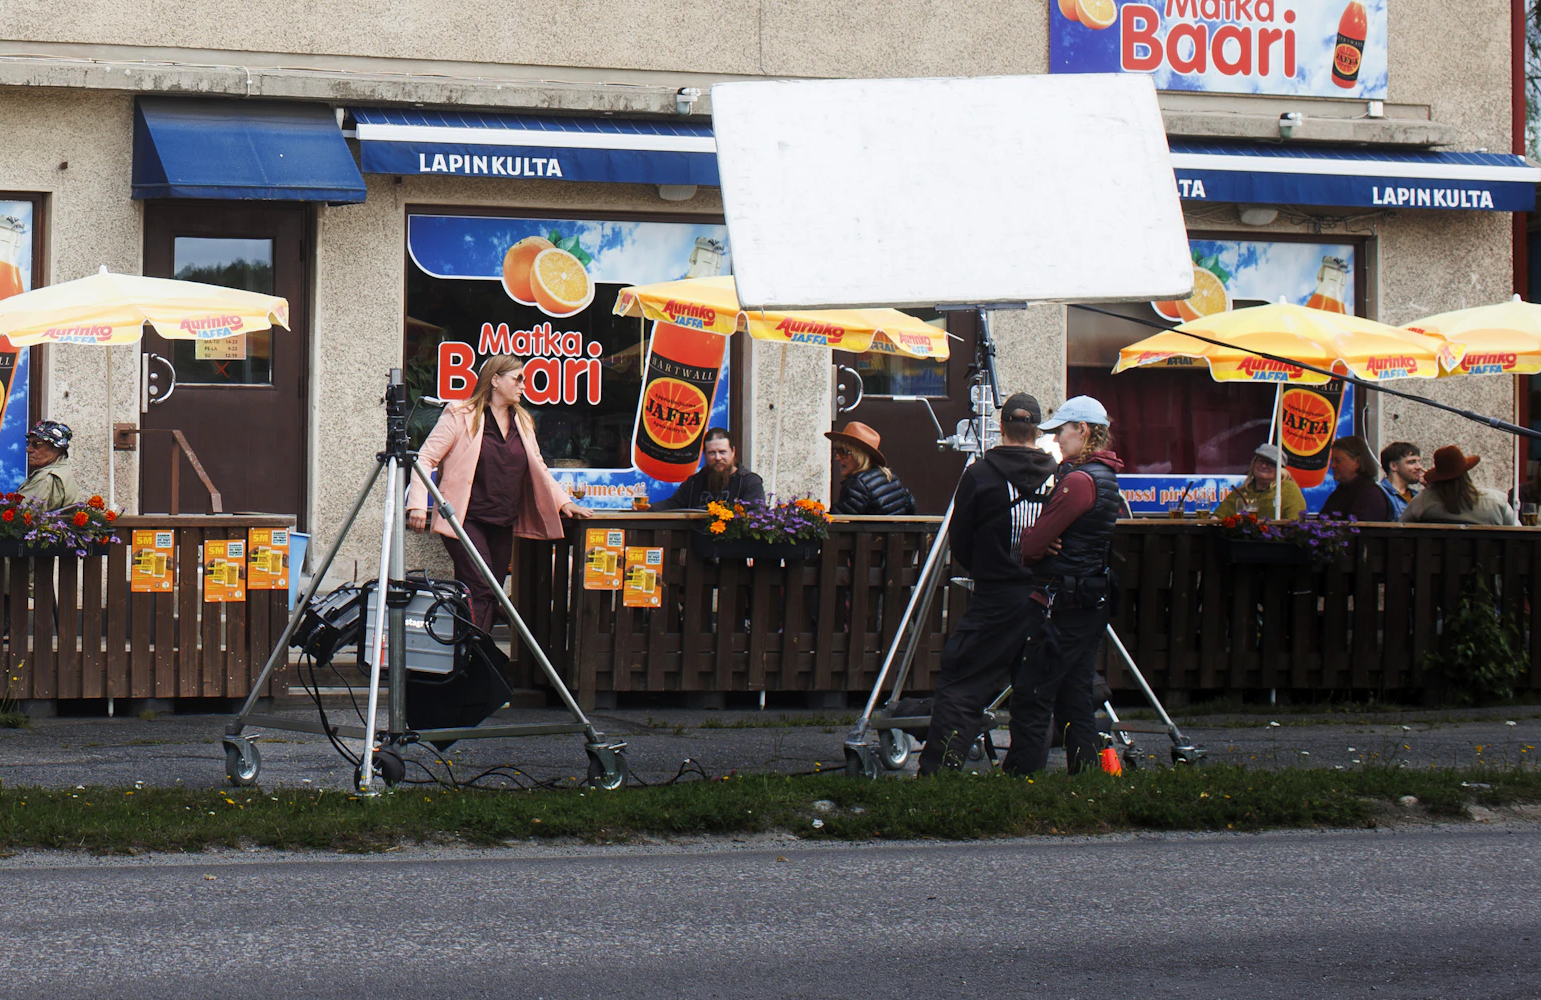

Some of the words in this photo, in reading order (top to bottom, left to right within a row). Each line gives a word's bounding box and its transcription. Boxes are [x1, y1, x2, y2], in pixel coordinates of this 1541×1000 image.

[1122, 3, 1296, 78] Baari
[662, 299, 716, 328] Aurinko
[180, 313, 244, 336] Aurinko
[675, 315, 704, 329] JAFFA
[41, 325, 113, 341] Aurinko
[775, 317, 845, 344] Aurinko
[58, 335, 97, 344] JAFFA
[478, 321, 582, 357] Matka
[790, 332, 827, 346] JAFFA
[437, 340, 603, 405] Bari
[652, 356, 713, 380] HARTWALL
[1366, 354, 1418, 377] Aurinko
[1468, 364, 1503, 375] JAFFA
[1252, 371, 1289, 381] JAFFA
[1378, 368, 1409, 380] JAFFA
[646, 398, 701, 426] JAFFA
[137, 536, 153, 545] SM
[253, 534, 269, 543] SM
[589, 535, 605, 544] SM
[208, 546, 224, 555] SM
[629, 553, 644, 561] SM
